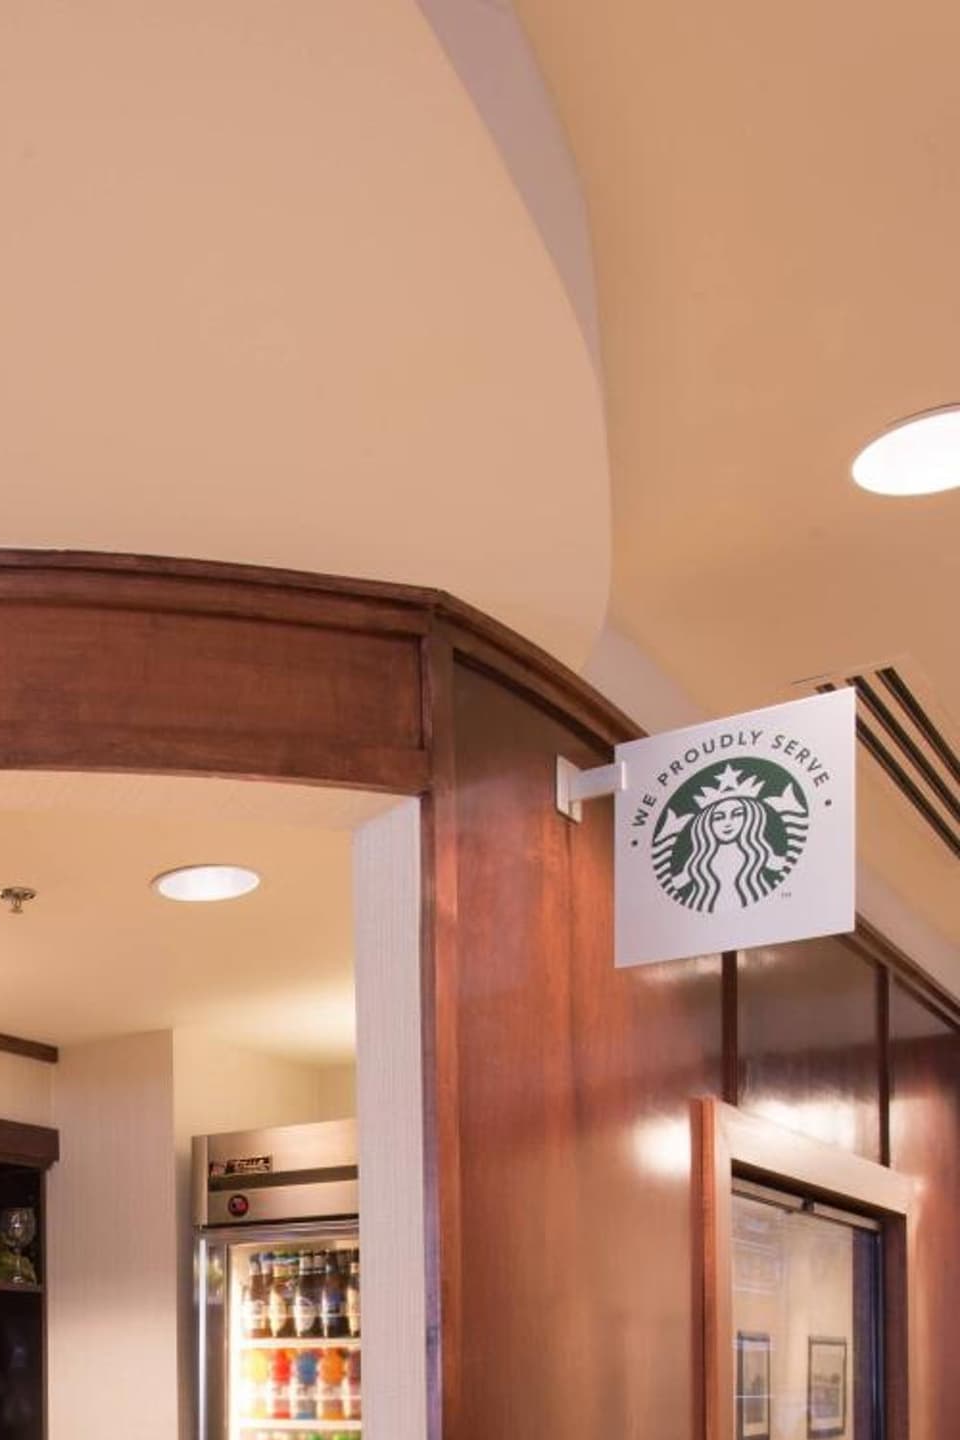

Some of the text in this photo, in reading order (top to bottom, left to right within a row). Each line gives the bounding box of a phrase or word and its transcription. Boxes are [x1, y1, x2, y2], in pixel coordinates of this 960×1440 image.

[633, 730, 830, 828] WE PROUDLY SERVE
